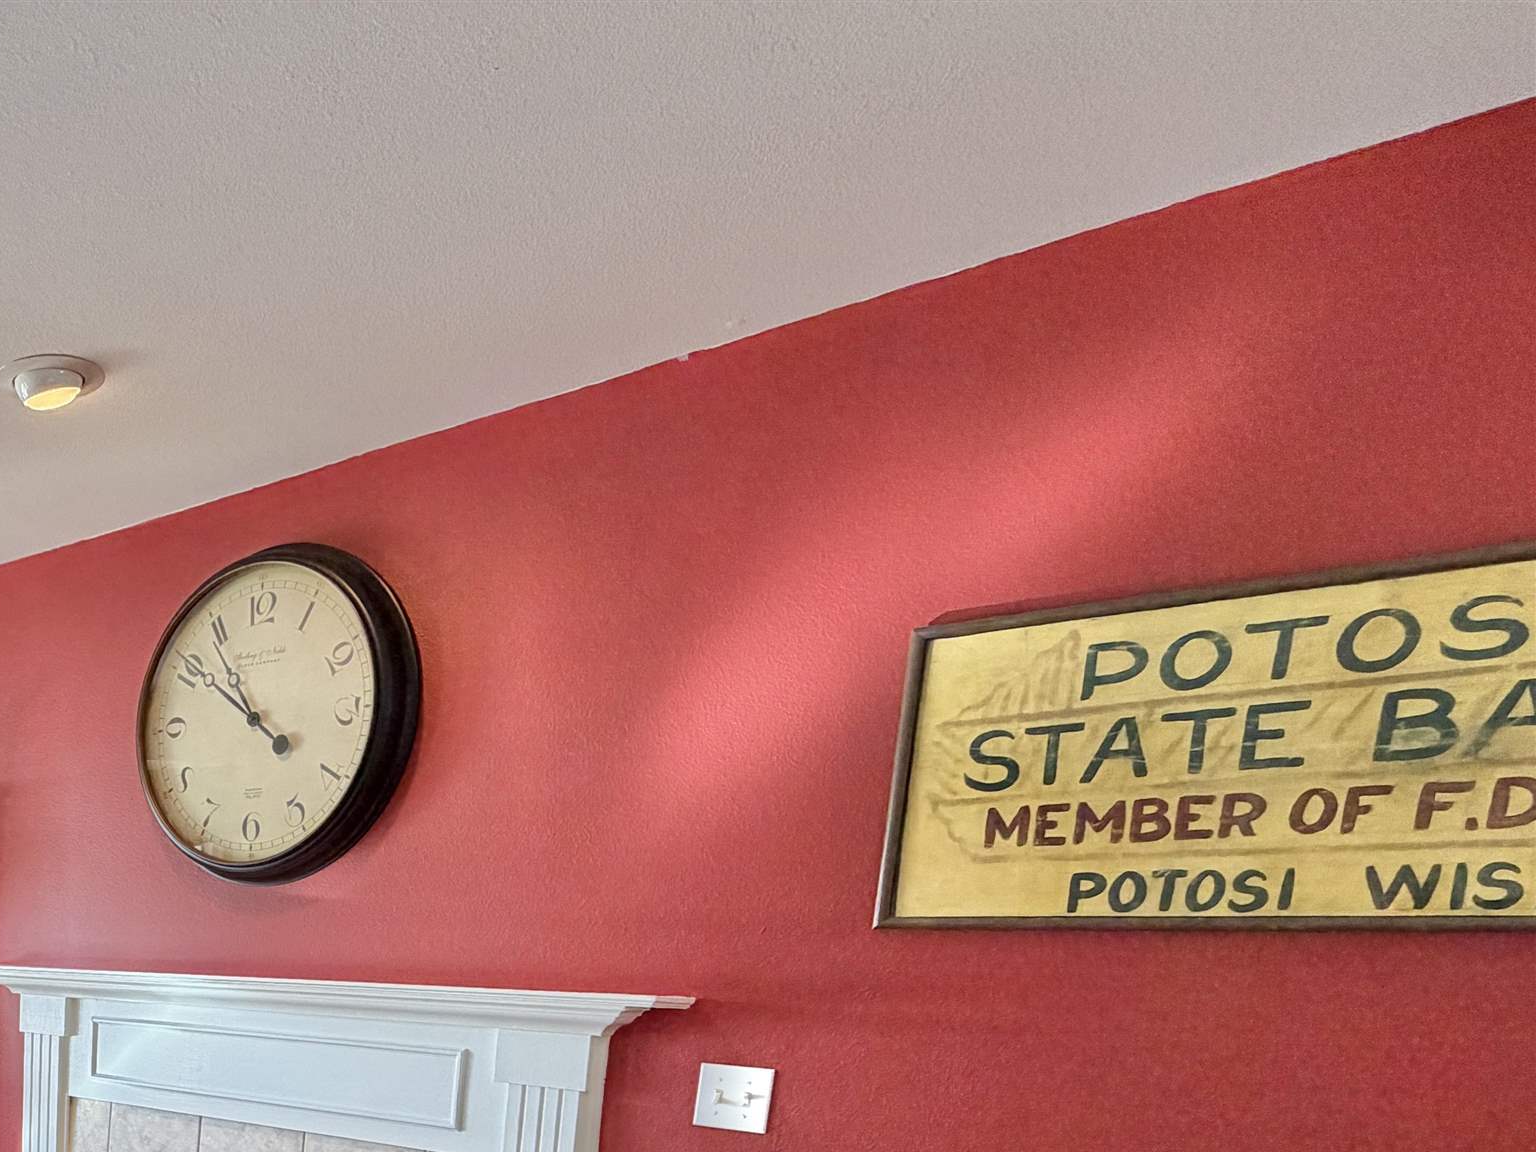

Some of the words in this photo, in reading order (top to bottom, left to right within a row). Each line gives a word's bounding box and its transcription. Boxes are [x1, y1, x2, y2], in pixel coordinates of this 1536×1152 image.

[250, 591, 277, 626] 12
[298, 601, 315, 631] 1
[210, 614, 229, 647] 11
[1081, 594, 1530, 700] POTOS
[177, 653, 204, 689] 10
[324, 641, 354, 676] 2
[333, 694, 361, 726] 3
[964, 699, 1312, 793] STATE
[1373, 678, 1536, 763] BA
[320, 762, 344, 791] 4
[201, 797, 221, 828] 7
[241, 812, 260, 842] 6
[283, 793, 306, 828] 5
[983, 792, 1268, 849] MEMBER
[1288, 784, 1393, 834] OF
[1066, 867, 1296, 914] POTOSI
[1364, 861, 1524, 912] WIS
